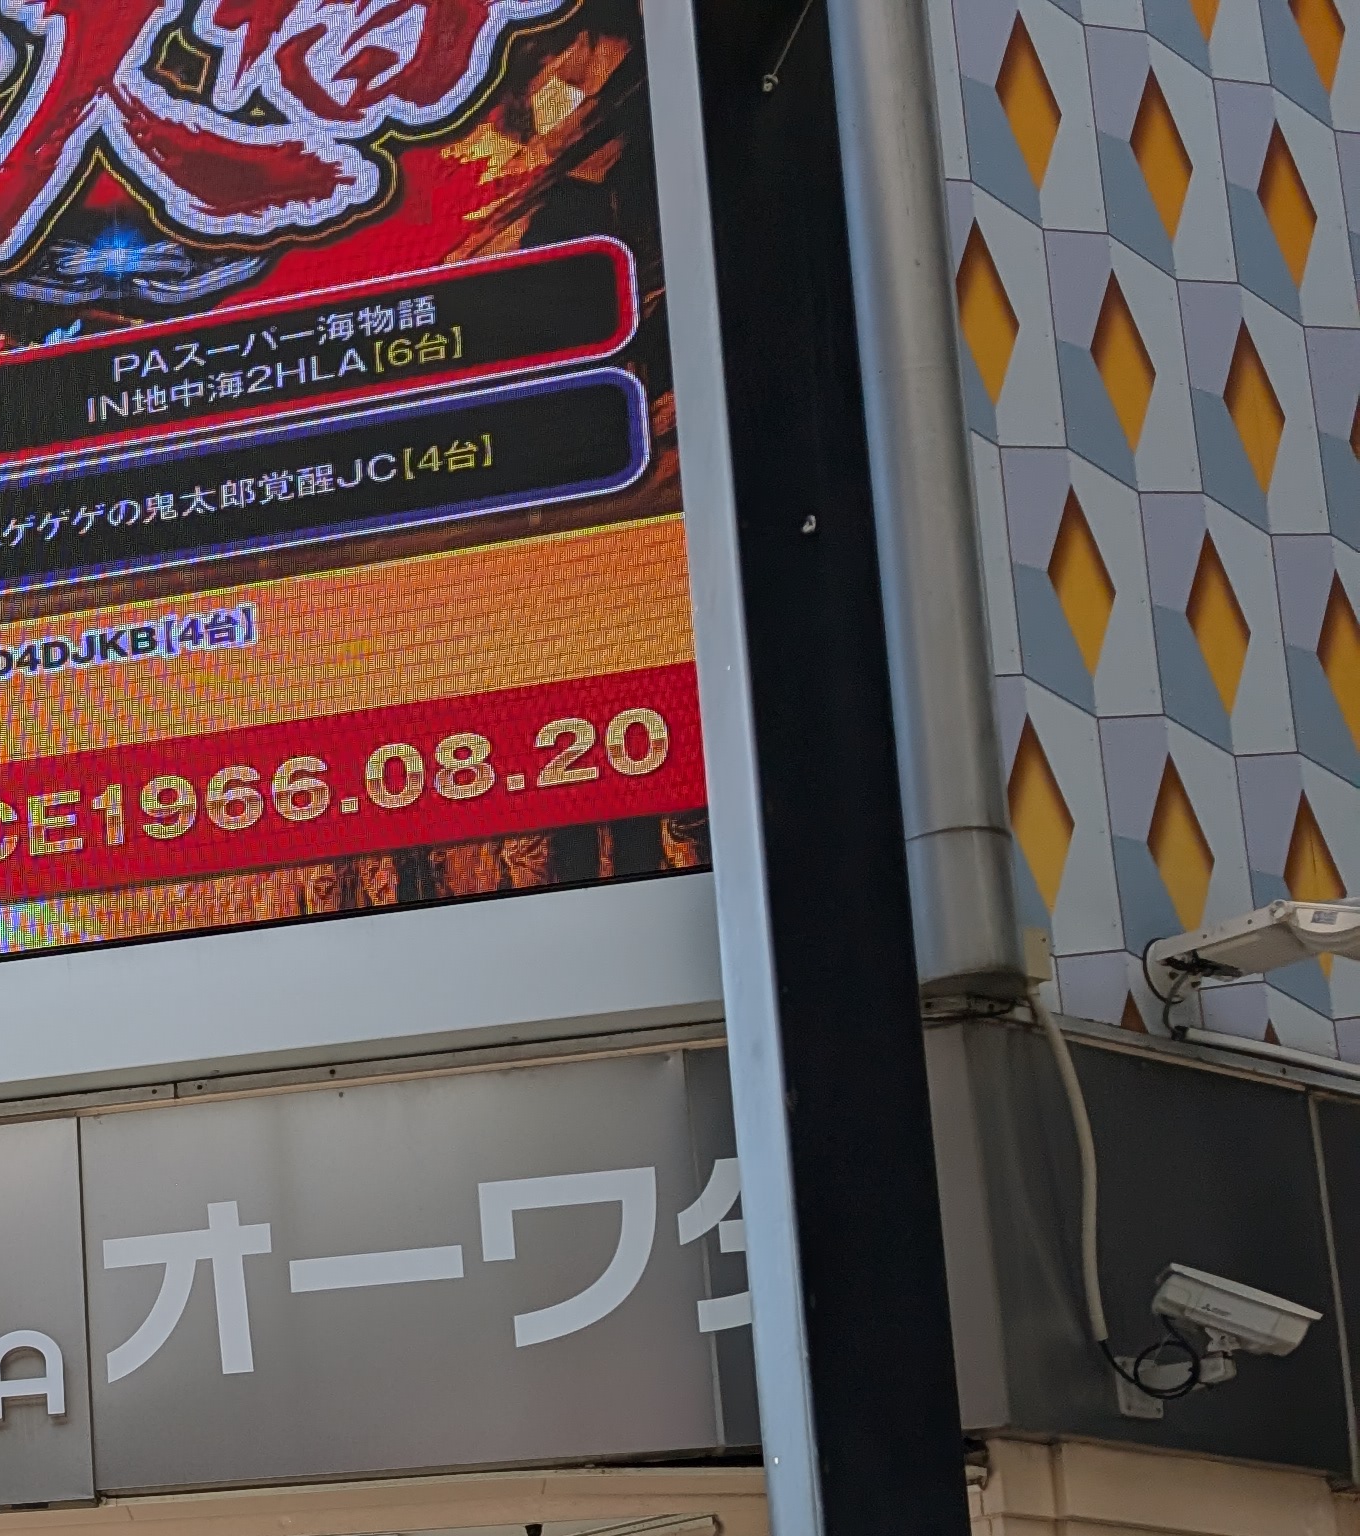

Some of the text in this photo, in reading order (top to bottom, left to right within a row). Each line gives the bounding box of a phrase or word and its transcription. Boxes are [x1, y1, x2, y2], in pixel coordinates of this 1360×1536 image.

[85, 325, 466, 425] IN地中海2HLA【6台】
[112, 298, 437, 382] PAスーパー海物語
